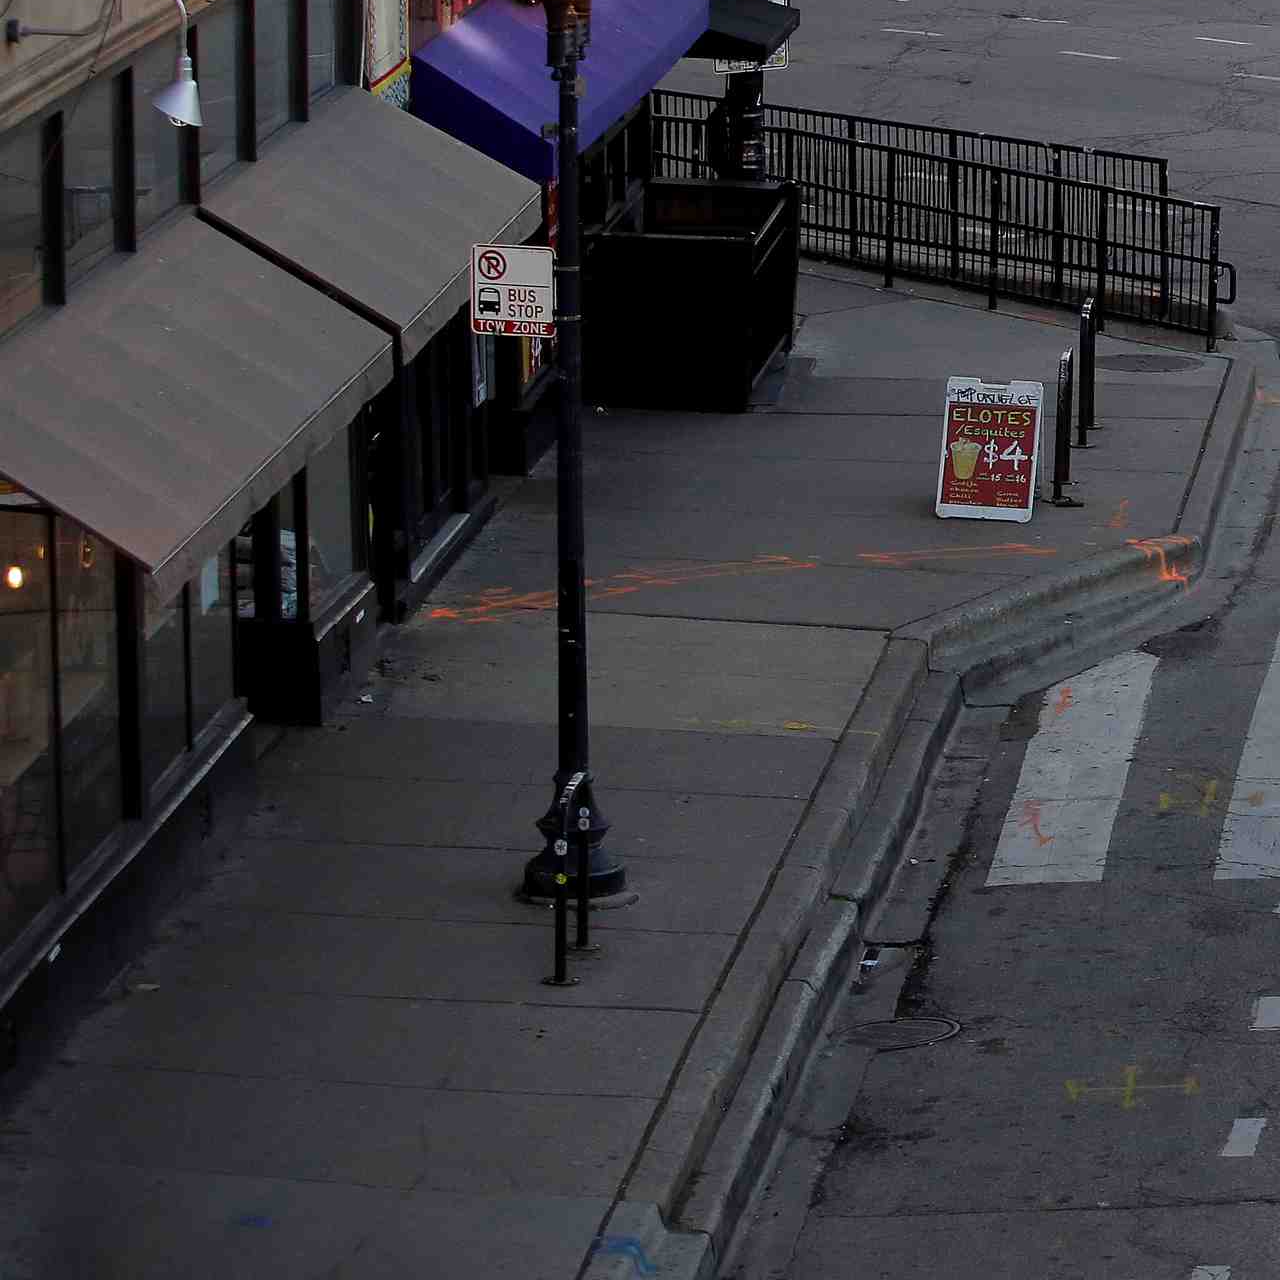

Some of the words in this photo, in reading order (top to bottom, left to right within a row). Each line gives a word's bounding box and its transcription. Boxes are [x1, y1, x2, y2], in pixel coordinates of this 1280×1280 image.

[508, 288, 537, 303] BUS
[508, 304, 544, 319] STOP
[480, 320, 506, 333] TOW
[512, 322, 548, 335] ZONE
[952, 407, 1032, 426] ELOTES
[983, 438, 1029, 471] $4
